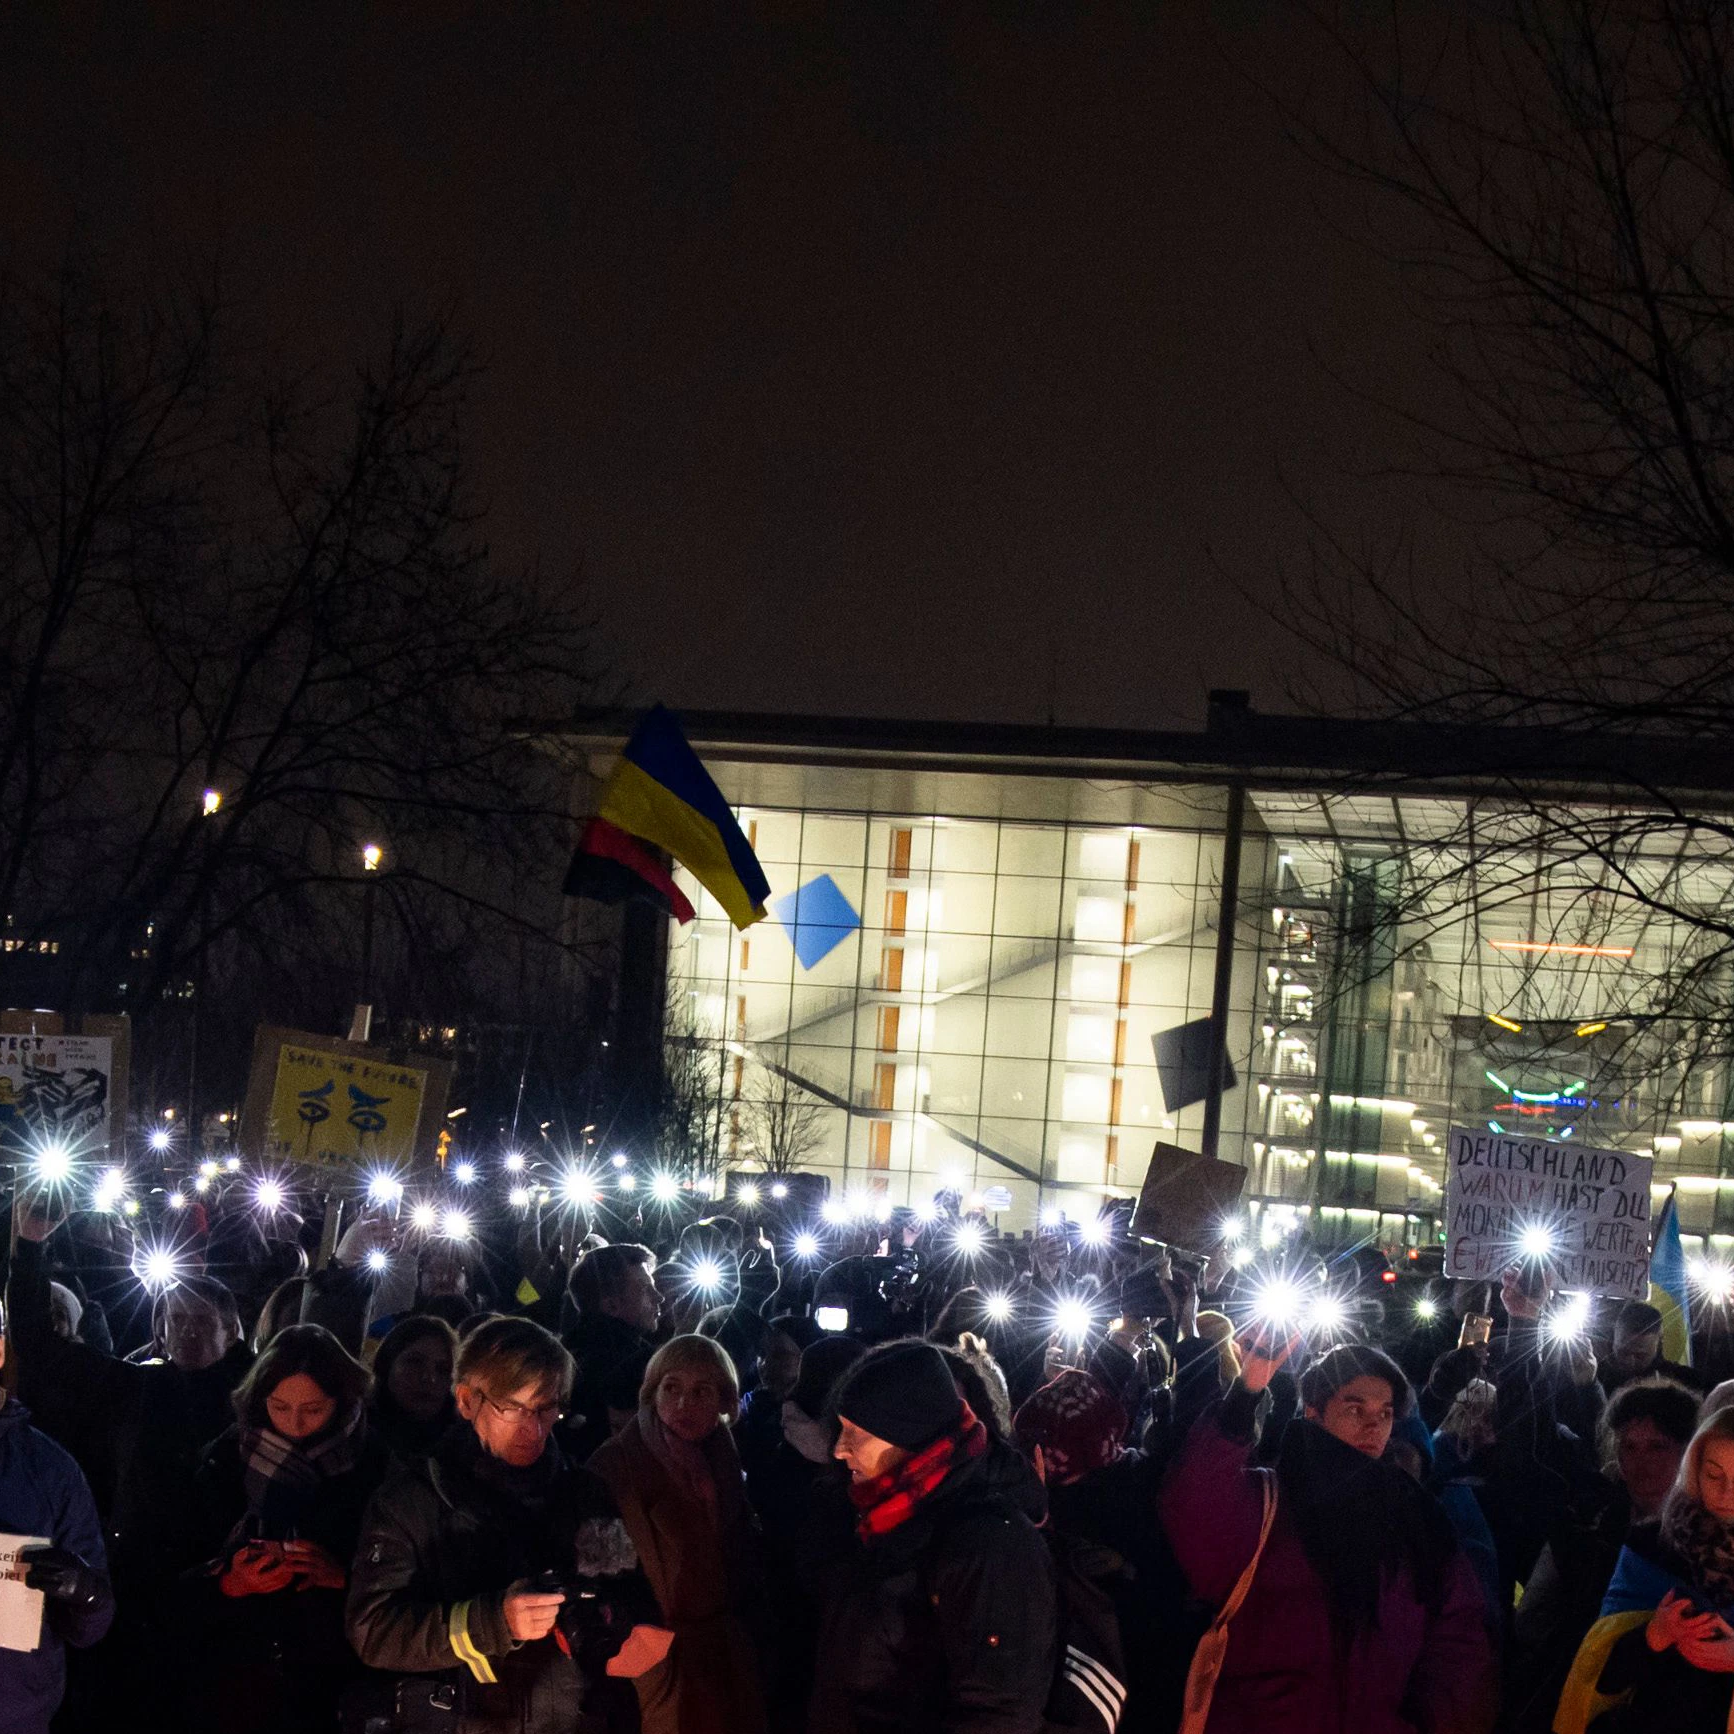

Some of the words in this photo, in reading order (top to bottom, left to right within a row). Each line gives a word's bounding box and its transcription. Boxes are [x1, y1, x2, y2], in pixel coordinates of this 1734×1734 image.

[1457, 1134, 1627, 1185] DEUTSCHLAND
[1457, 1168, 1546, 1202] WARUM
[1553, 1182, 1605, 1214] HAST
[1611, 1189, 1646, 1221] DU
[1582, 1221, 1635, 1253] WERTE
